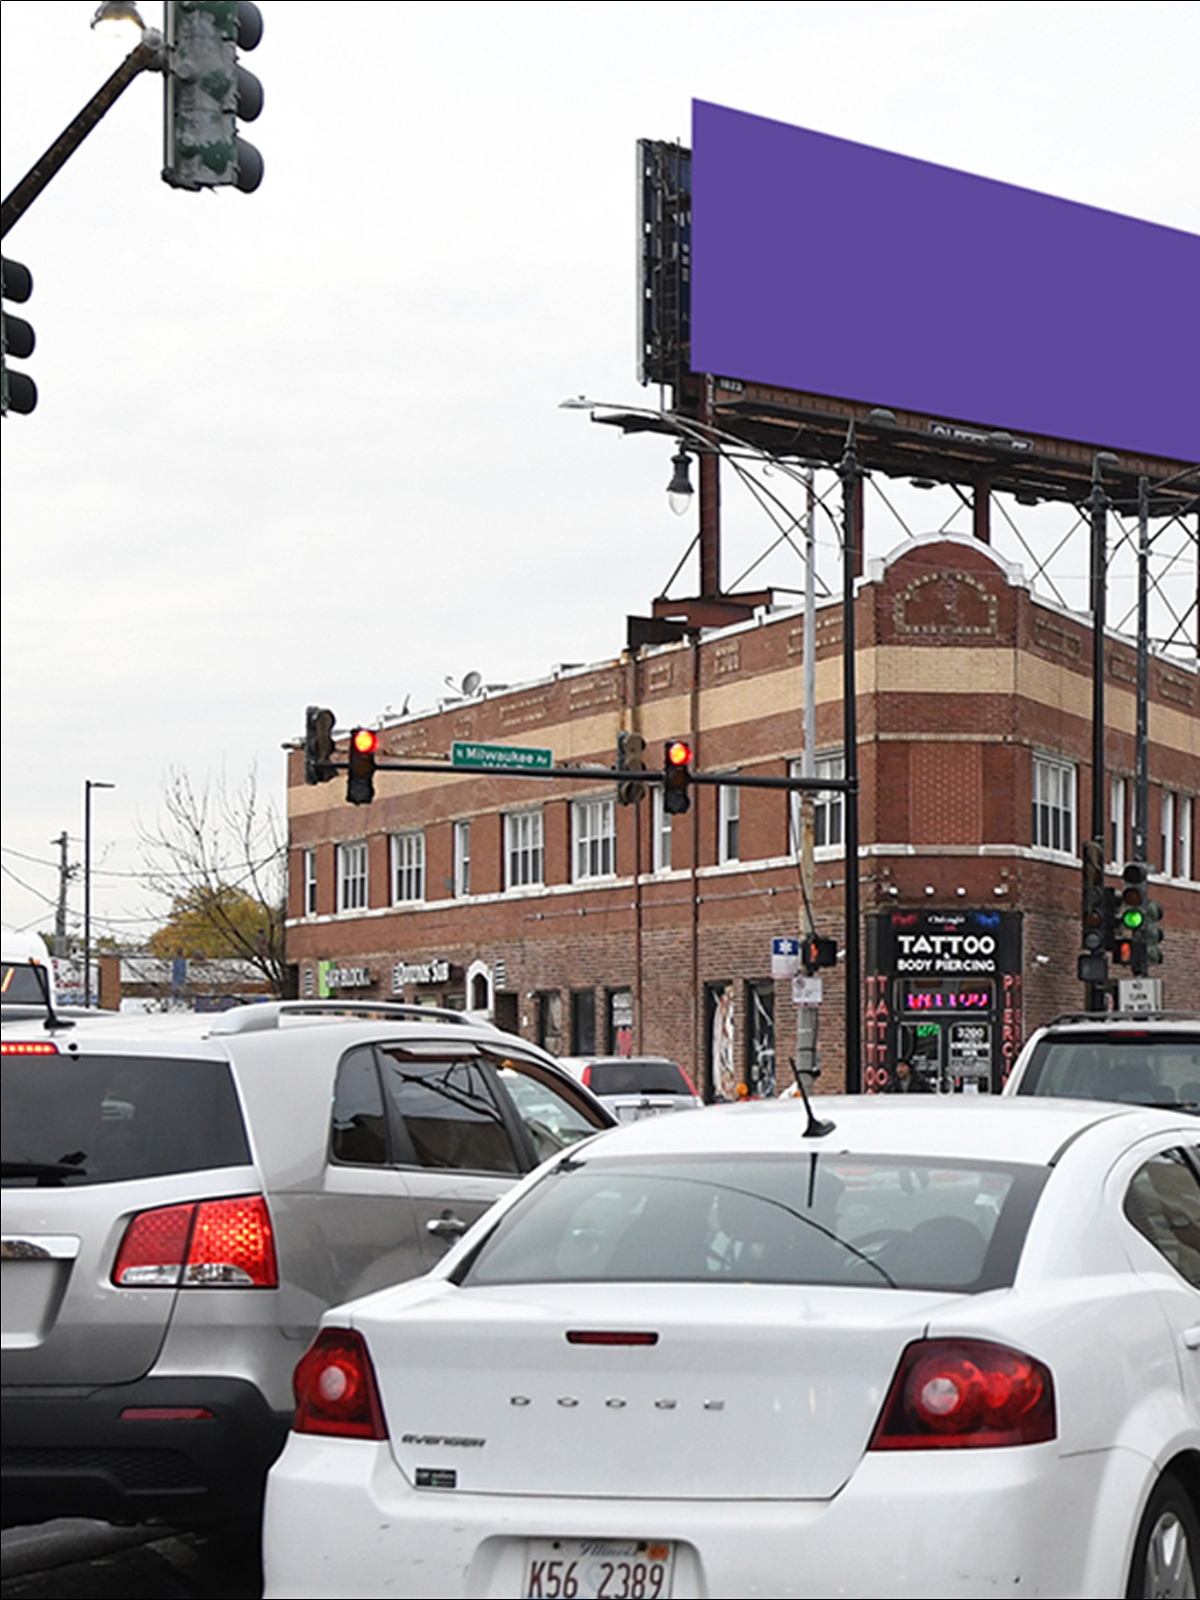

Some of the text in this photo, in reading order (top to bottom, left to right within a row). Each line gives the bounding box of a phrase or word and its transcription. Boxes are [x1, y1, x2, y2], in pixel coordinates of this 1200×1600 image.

[465, 747, 535, 765] Milwaukee
[897, 935, 996, 955] TATTOO
[897, 959, 996, 972] BODY PIERCING
[402, 1433, 487, 1449] AVENGER
[579, 1540, 638, 1558] Illinois
[528, 1560, 664, 1599] K56 2389
